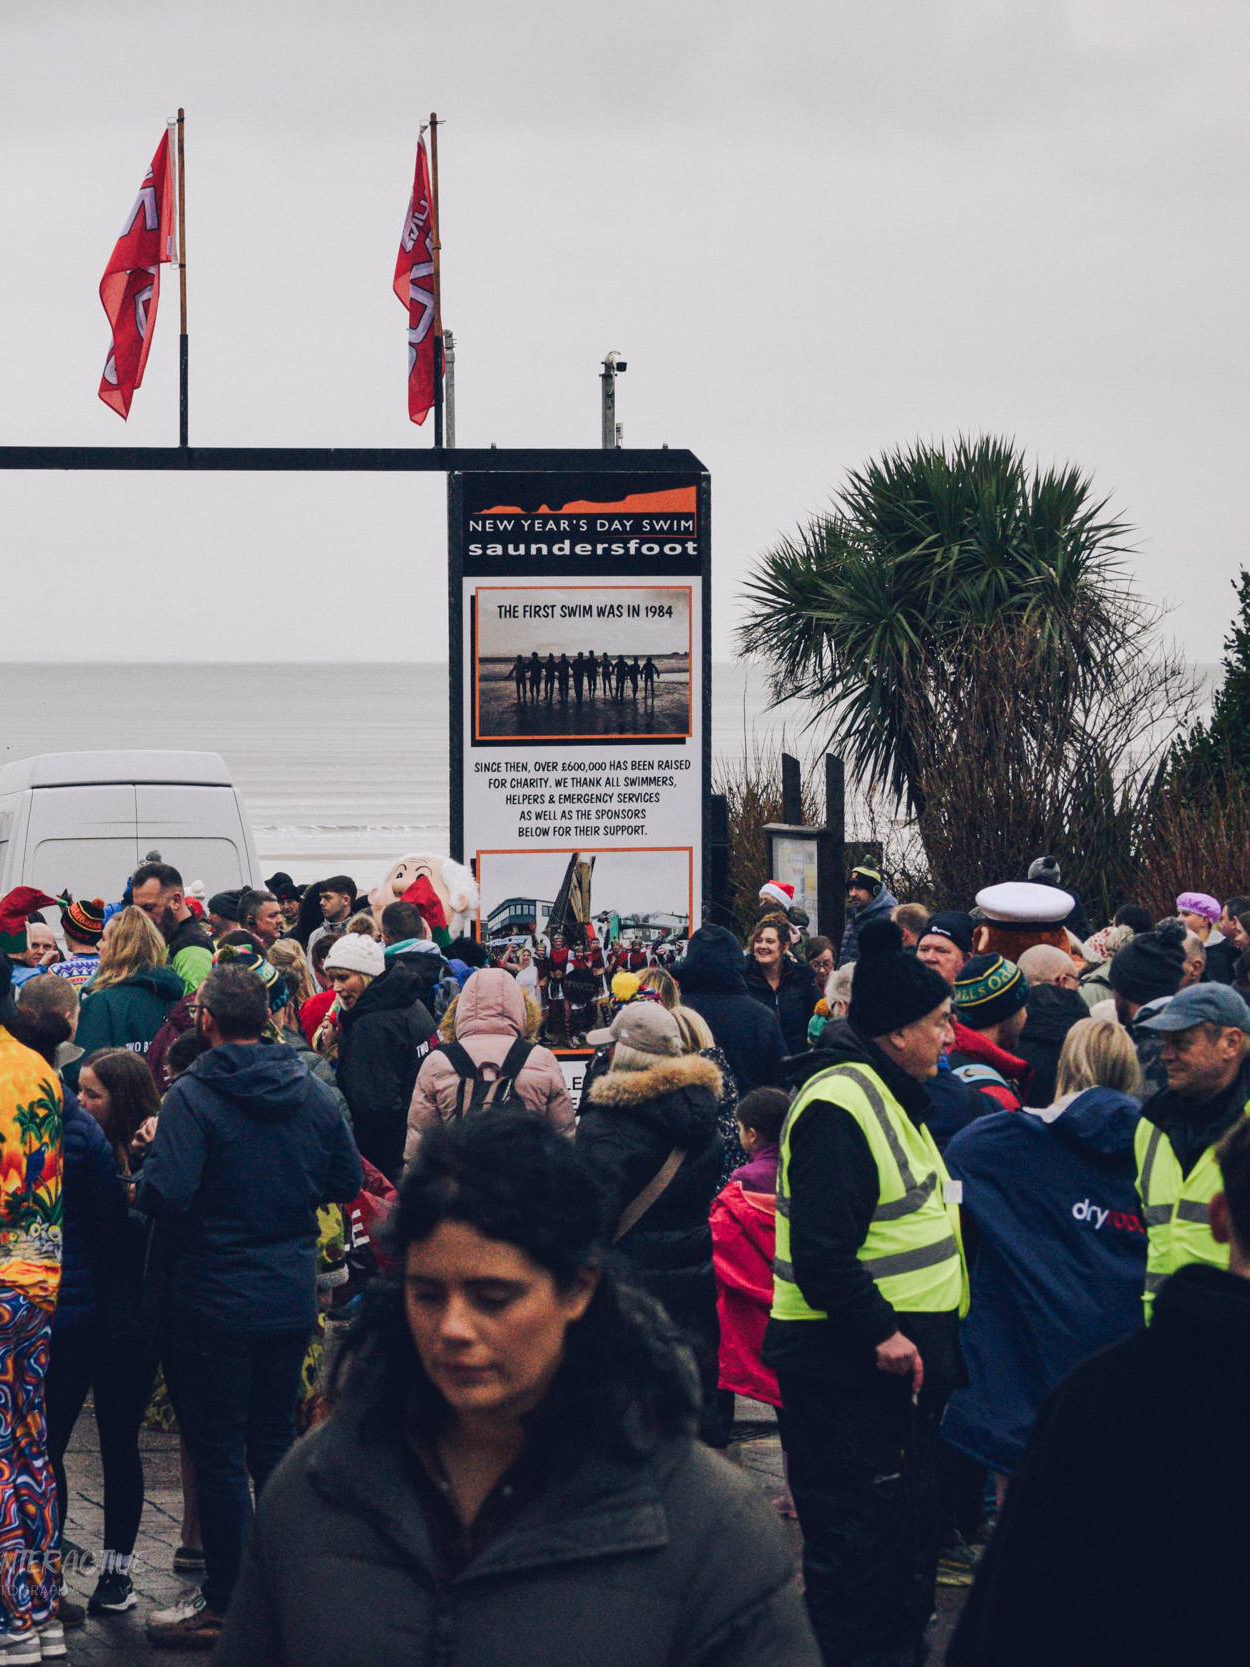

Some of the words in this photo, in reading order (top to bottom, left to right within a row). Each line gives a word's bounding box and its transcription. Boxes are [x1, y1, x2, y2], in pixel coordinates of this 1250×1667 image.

[469, 520, 515, 532] NEW
[521, 519, 588, 531] YEAR'S
[597, 520, 634, 531] DAY
[642, 519, 693, 531] SWIM
[468, 539, 698, 555] saundersfoot
[497, 605, 519, 619] THE
[523, 604, 556, 618] FIRST
[560, 604, 593, 618] SWIM
[596, 605, 623, 618] WAS
[627, 604, 640, 618] IN
[645, 605, 673, 618] 1984
[474, 762, 502, 773] SINCE
[504, 761, 530, 773] THEN,
[534, 761, 558, 772] OVER
[561, 761, 607, 773] £600,000
[609, 760, 628, 771] HAS
[631, 760, 654, 771] BEEN
[657, 759, 691, 770] RAISED
[488, 778, 507, 789] FOR
[510, 777, 552, 789] CHARITY.
[554, 777, 568, 788] WE
[571, 777, 602, 788] THANK
[604, 776, 621, 787] ALL
[623, 776, 677, 788] SWIMMERS,
[505, 794, 545, 805] HELPERS
[548, 794, 556, 804] &
[558, 793, 614, 804] EMERGENCY
[616, 792, 660, 803] SERVICES
[519, 810, 532, 821] AS
[535, 810, 557, 821] WELL
[560, 810, 573, 821] AS
[575, 809, 592, 820] THE
[595, 809, 646, 820] SPONSORS
[518, 826, 550, 837] BELOW
[552, 826, 572, 837] FOR
[574, 825, 600, 836] THEIR
[603, 825, 648, 836] SUPPORT.
